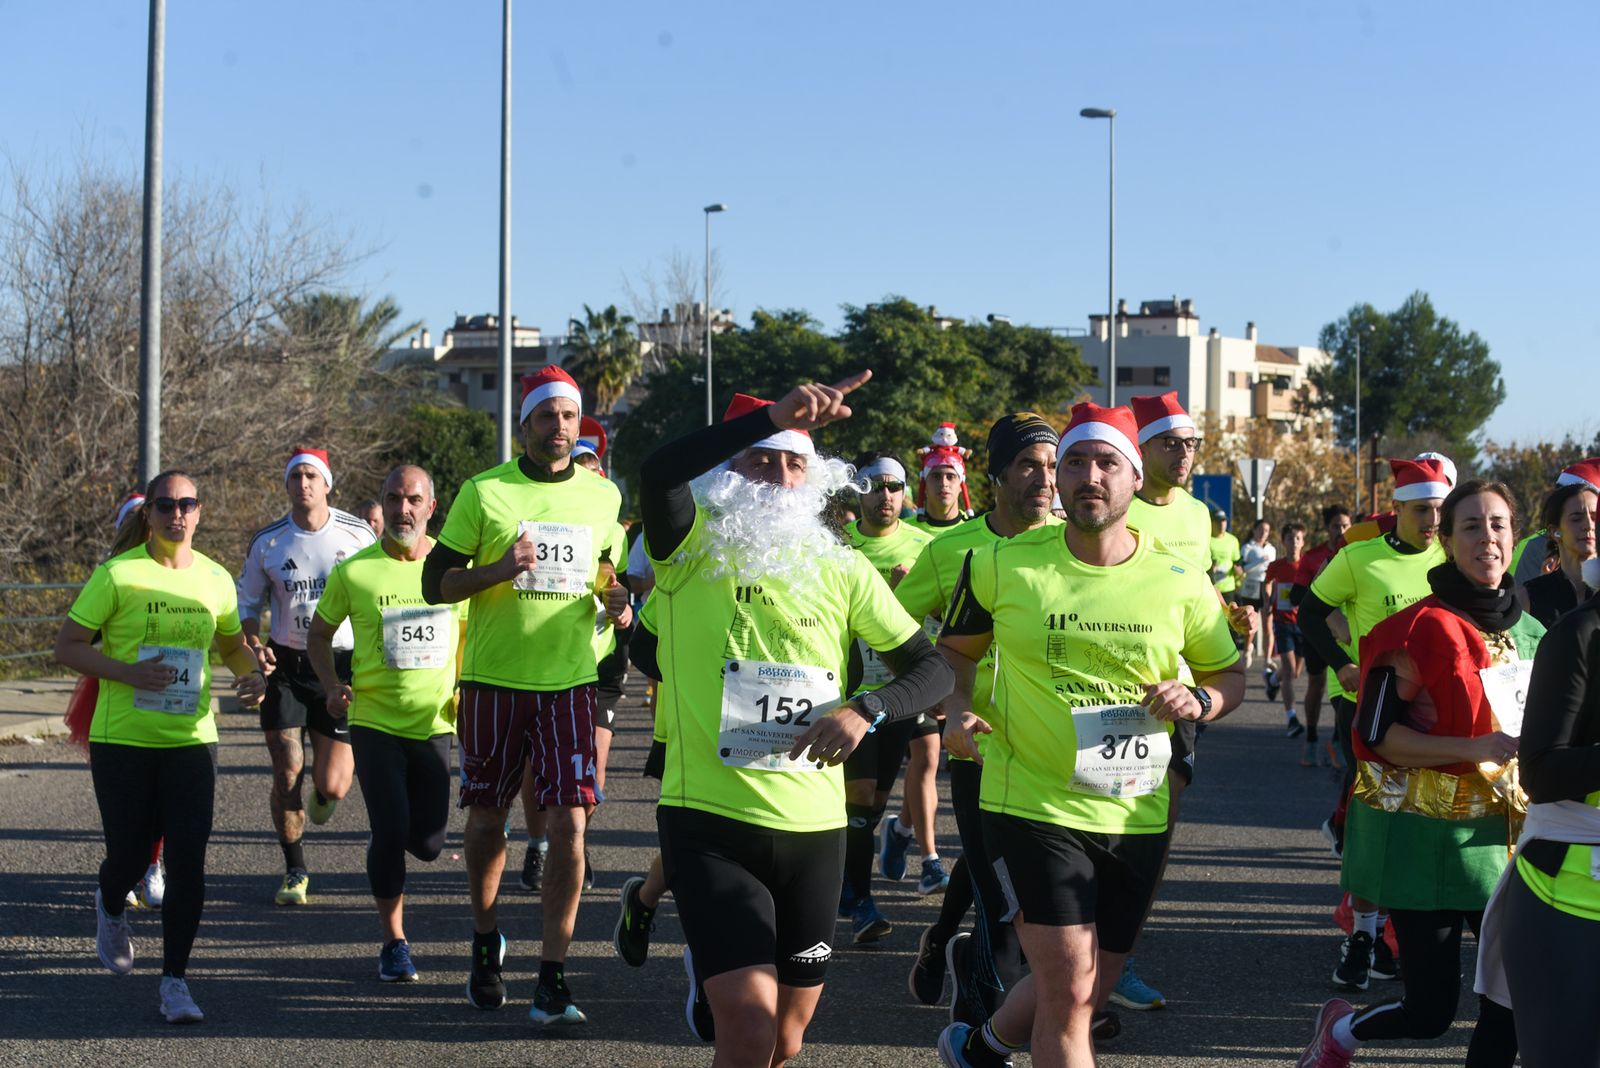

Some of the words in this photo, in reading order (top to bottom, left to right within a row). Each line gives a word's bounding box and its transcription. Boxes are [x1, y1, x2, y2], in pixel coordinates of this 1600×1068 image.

[536, 543, 574, 563] 313
[284, 576, 325, 592] Emira
[294, 615, 311, 629] 16
[1076, 622, 1153, 633] ANIVERSARIO
[401, 625, 435, 642] 543
[1055, 682, 1085, 694] SAN
[755, 694, 813, 727] 152
[1100, 734, 1149, 760] 376
